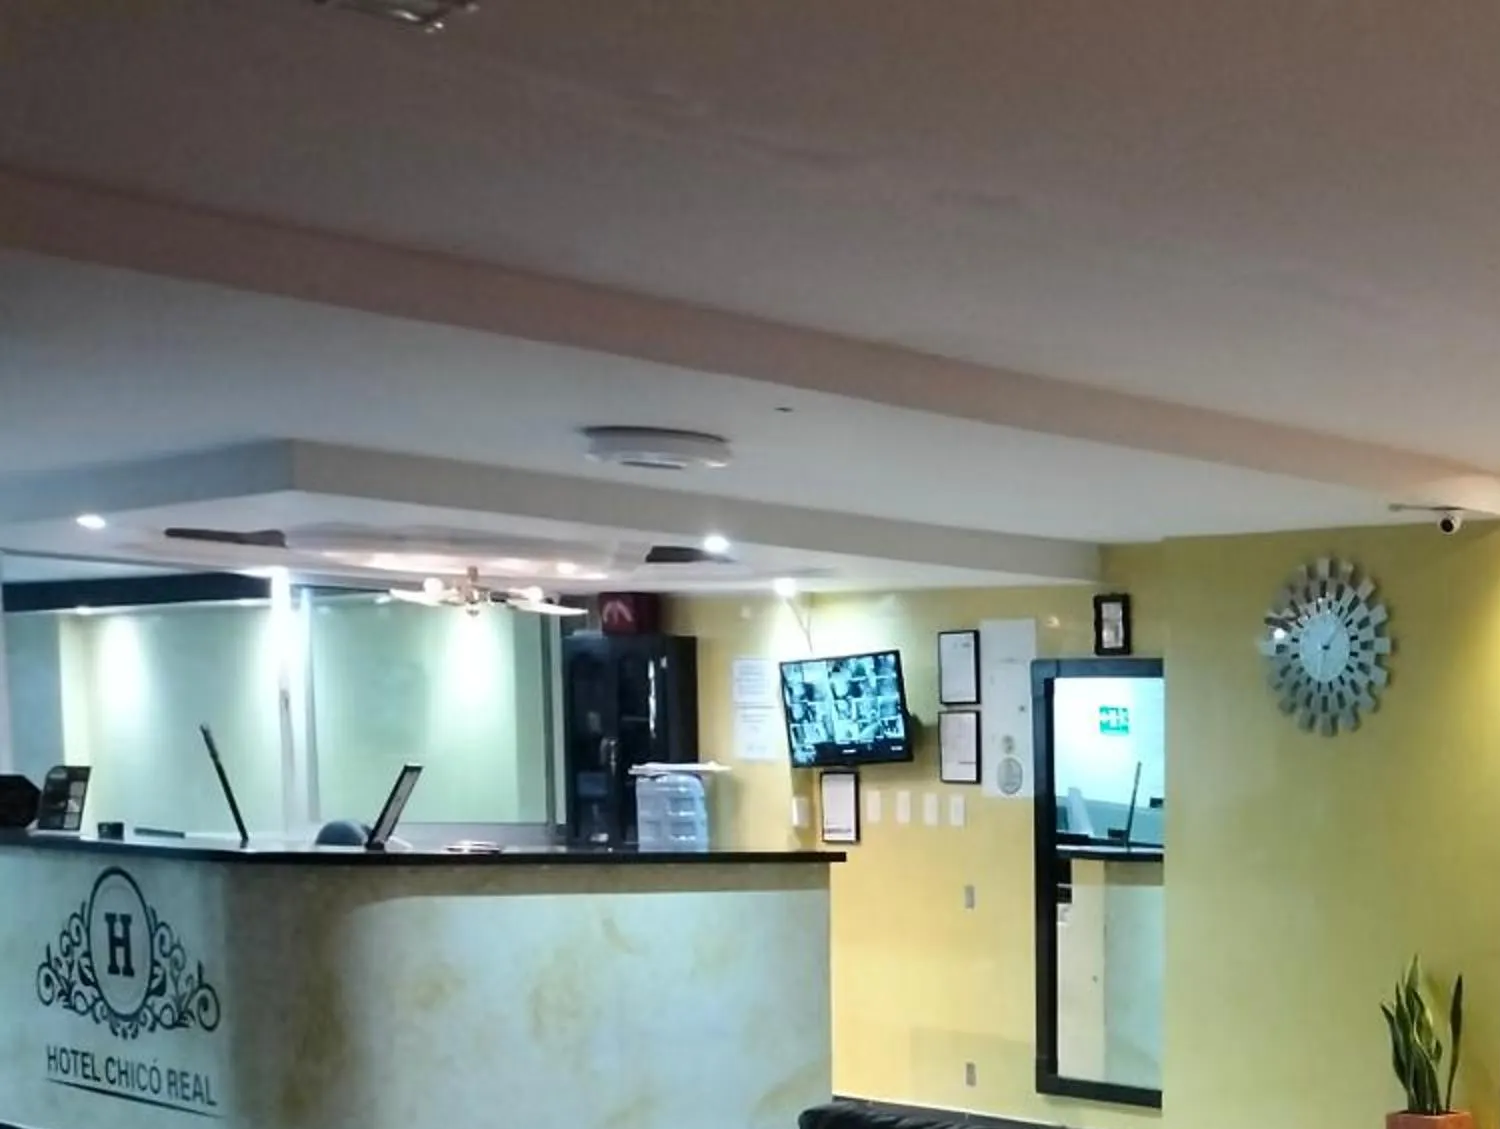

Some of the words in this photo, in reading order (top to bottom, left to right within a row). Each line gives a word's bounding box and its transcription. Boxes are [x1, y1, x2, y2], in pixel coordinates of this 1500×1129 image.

[105, 912, 135, 977] H
[46, 1044, 101, 1082] HOTEL
[104, 1056, 162, 1095] CHICÓ
[166, 1068, 217, 1107] REAL
